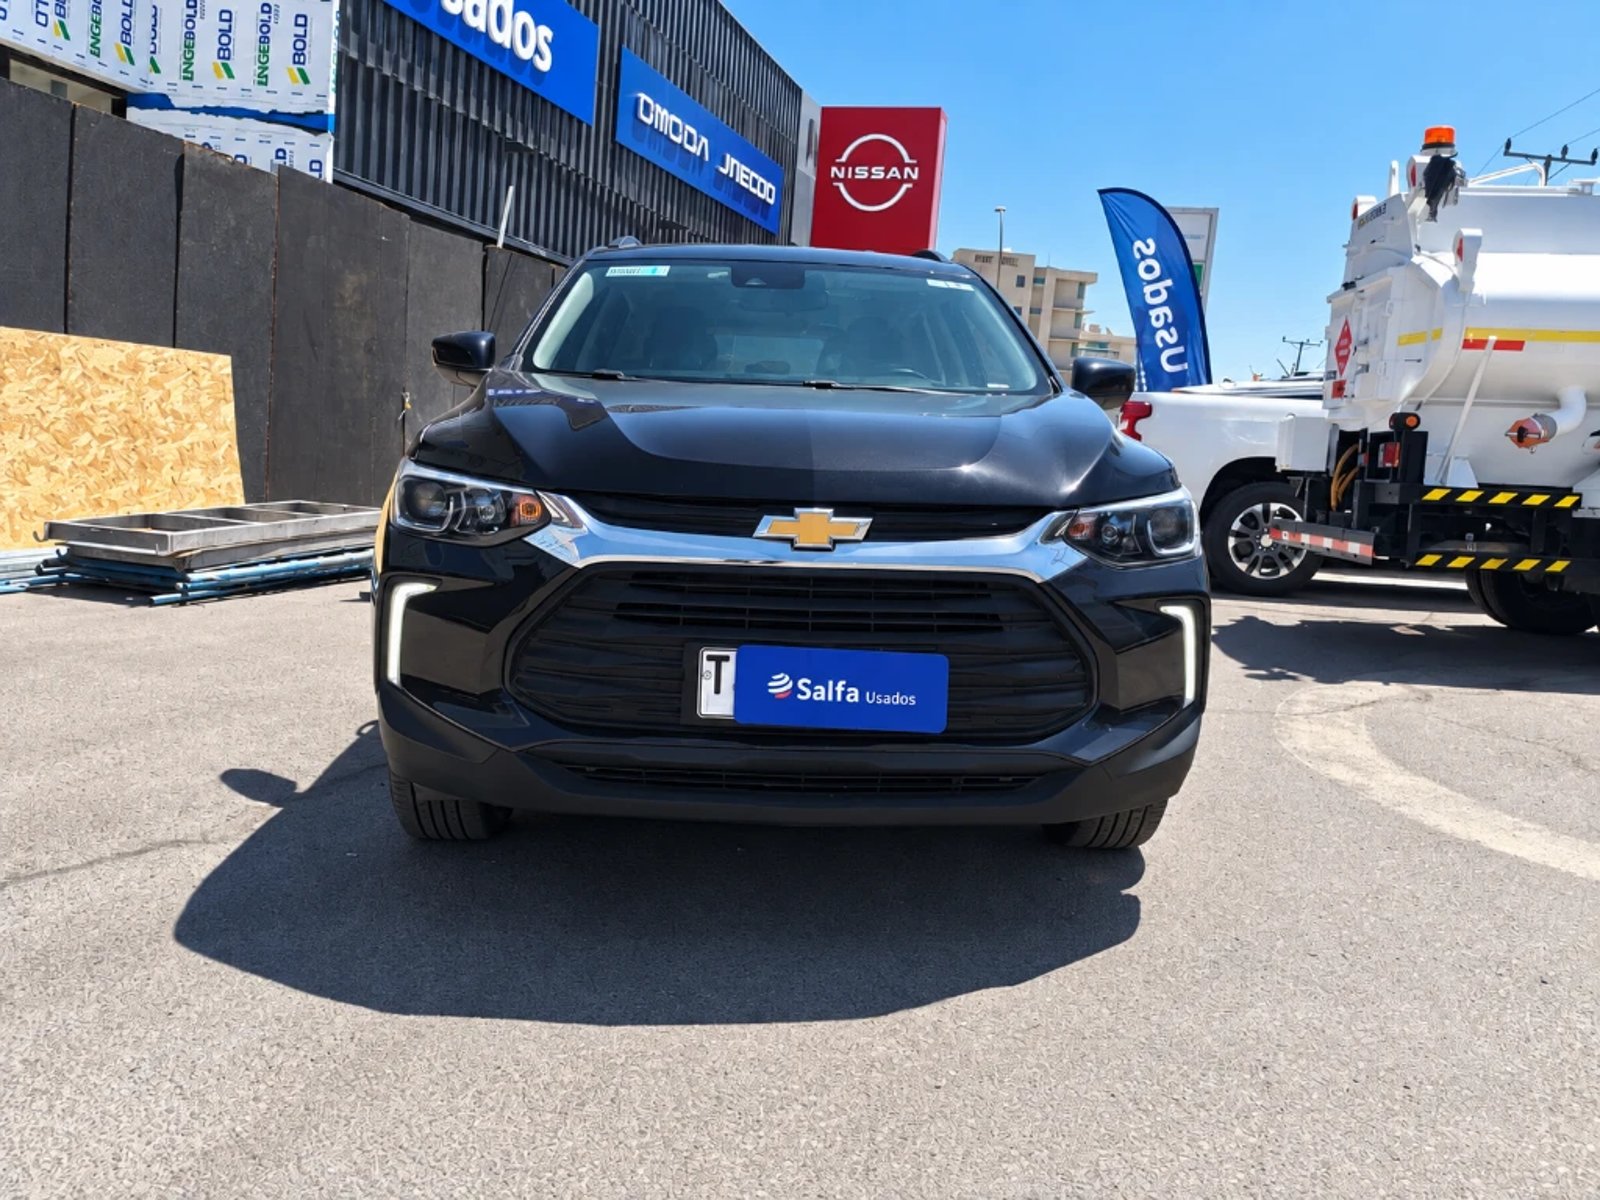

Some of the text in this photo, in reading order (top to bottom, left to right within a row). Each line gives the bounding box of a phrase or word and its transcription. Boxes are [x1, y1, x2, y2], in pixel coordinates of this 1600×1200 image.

[217, 9, 233, 61] BOLD
[292, 13, 308, 66] BOLD
[636, 92, 709, 161] OMODA
[831, 166, 919, 180] NISSAN
[706, 654, 731, 695] T
[796, 678, 917, 706] Salfa Usados
